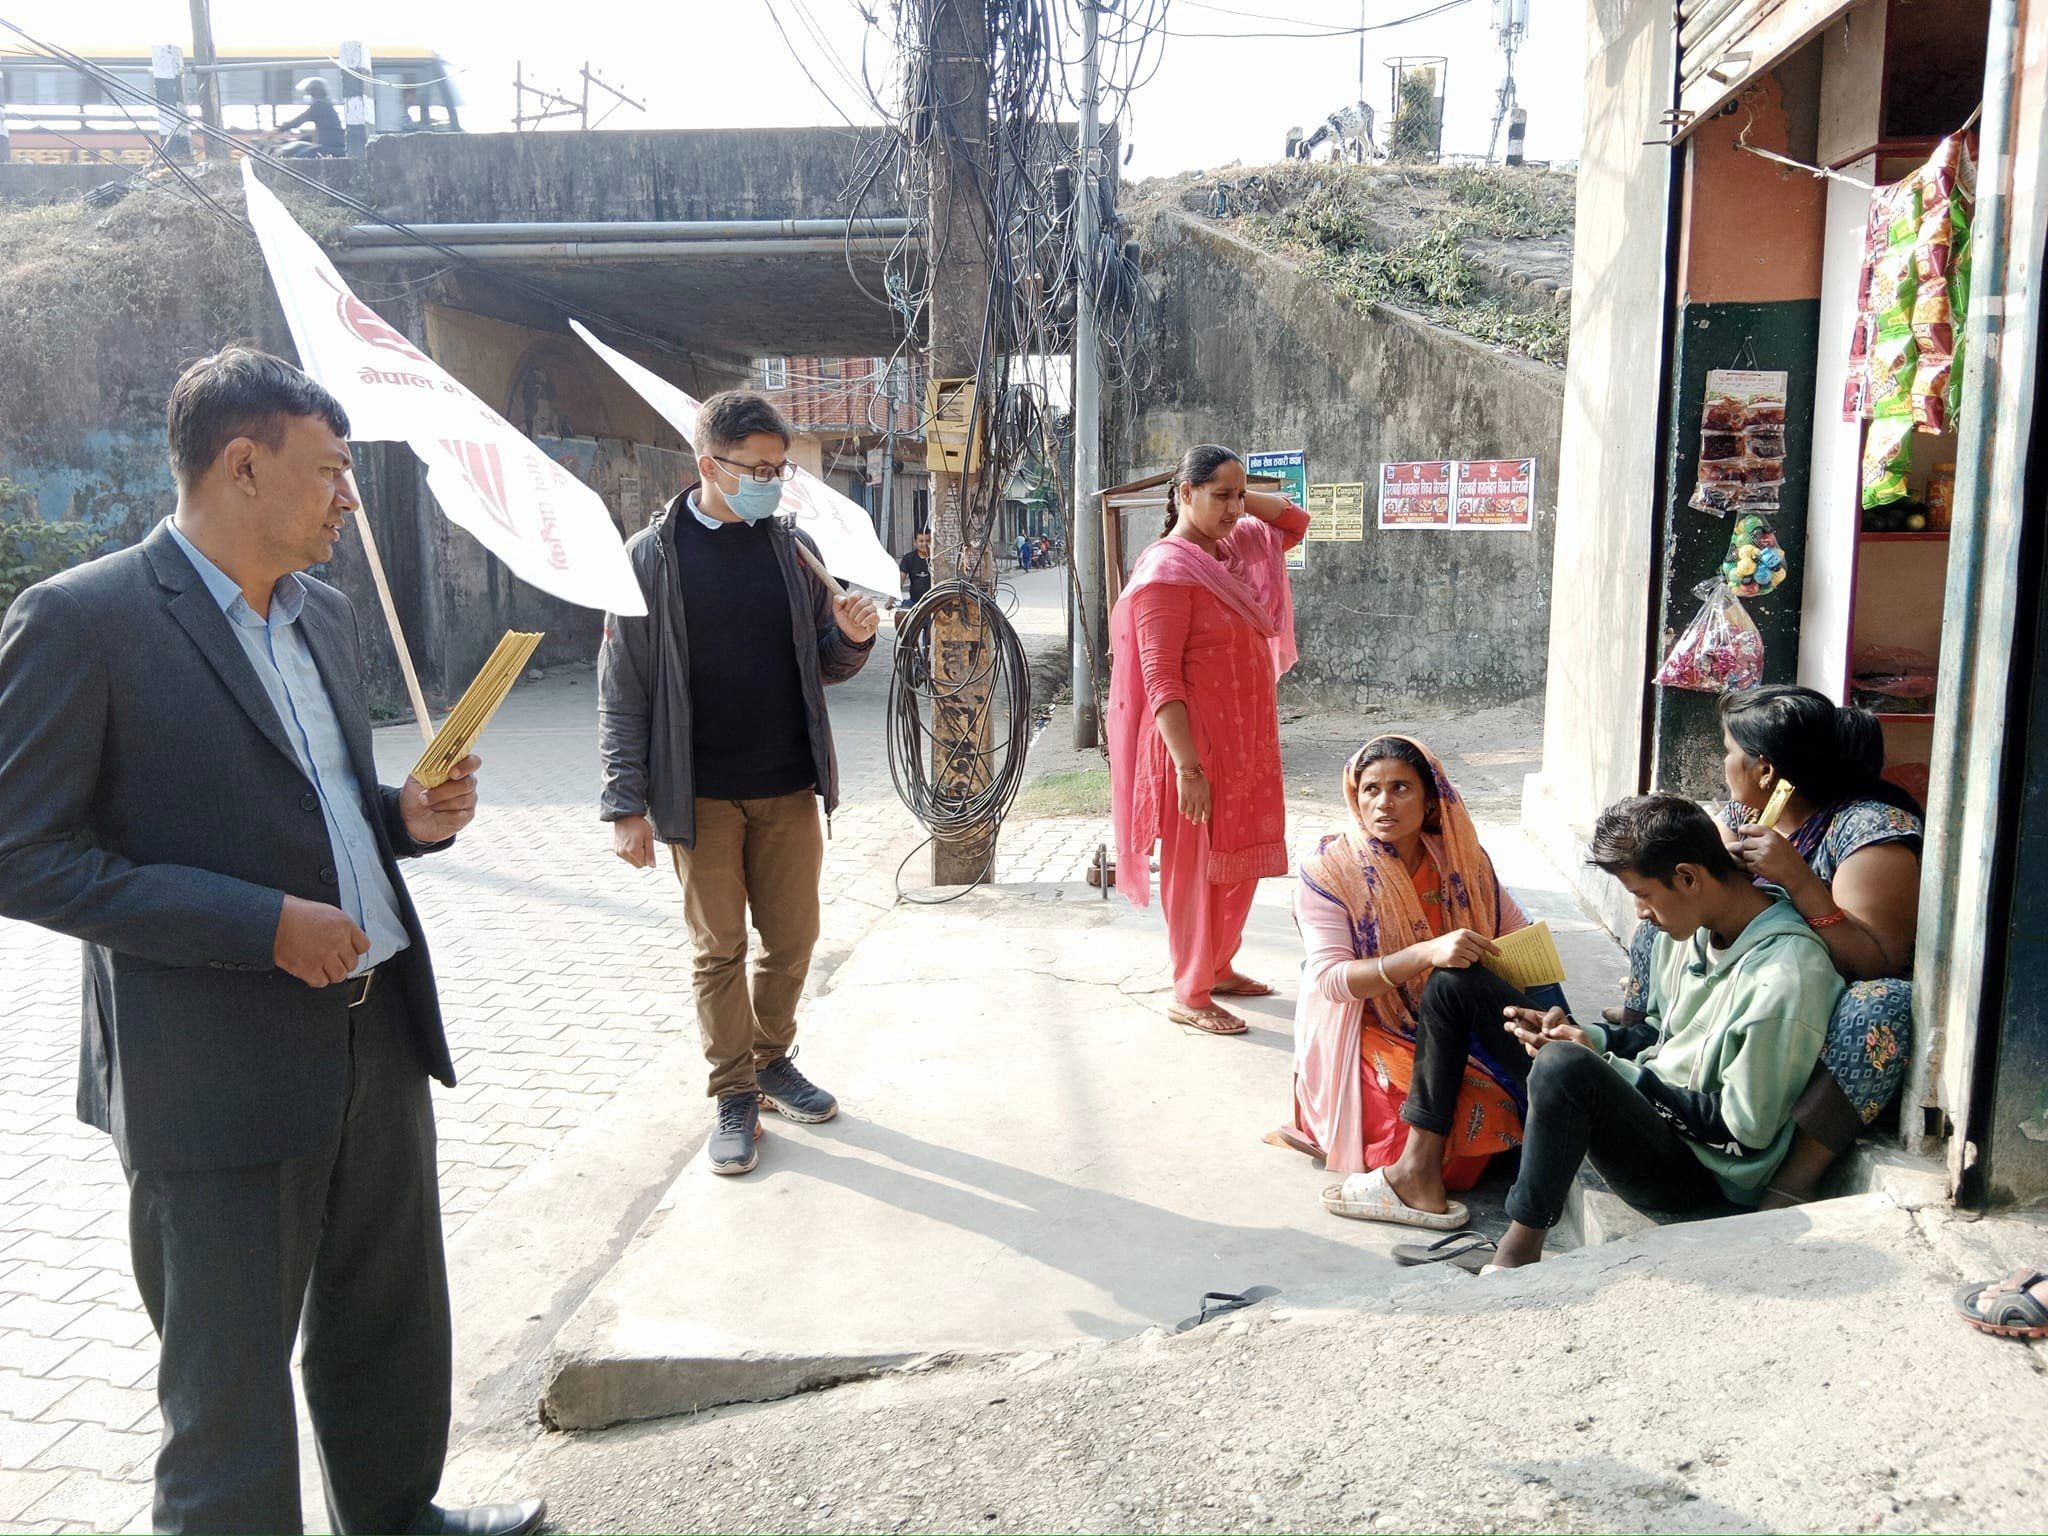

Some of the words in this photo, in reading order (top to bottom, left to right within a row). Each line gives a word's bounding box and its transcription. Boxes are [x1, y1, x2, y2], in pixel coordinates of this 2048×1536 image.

[357, 366, 435, 390] नेपाल
[1309, 487, 1333, 497] Computer
[1337, 486, 1361, 497] Computer
